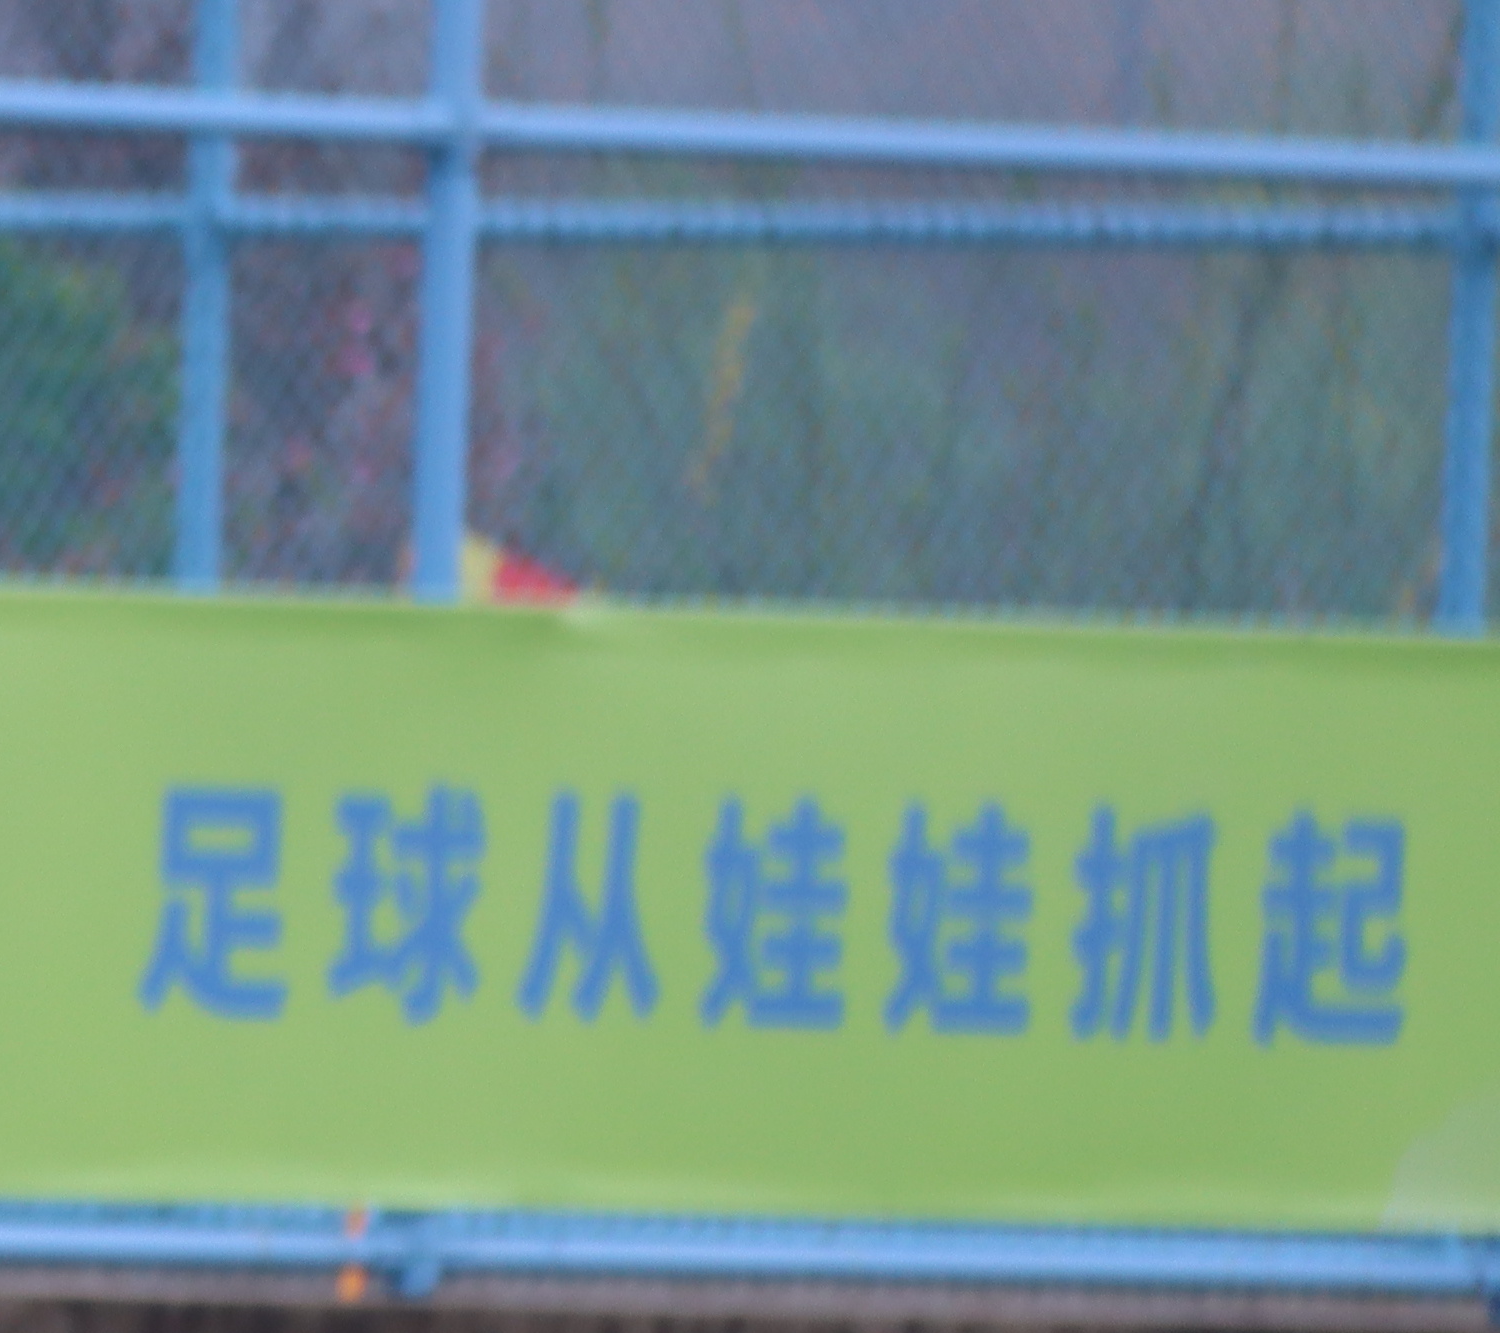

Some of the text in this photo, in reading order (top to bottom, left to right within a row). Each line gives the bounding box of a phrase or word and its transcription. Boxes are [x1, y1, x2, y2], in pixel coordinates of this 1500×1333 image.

[137, 783, 1408, 1047] 足球从娃娃抓起
